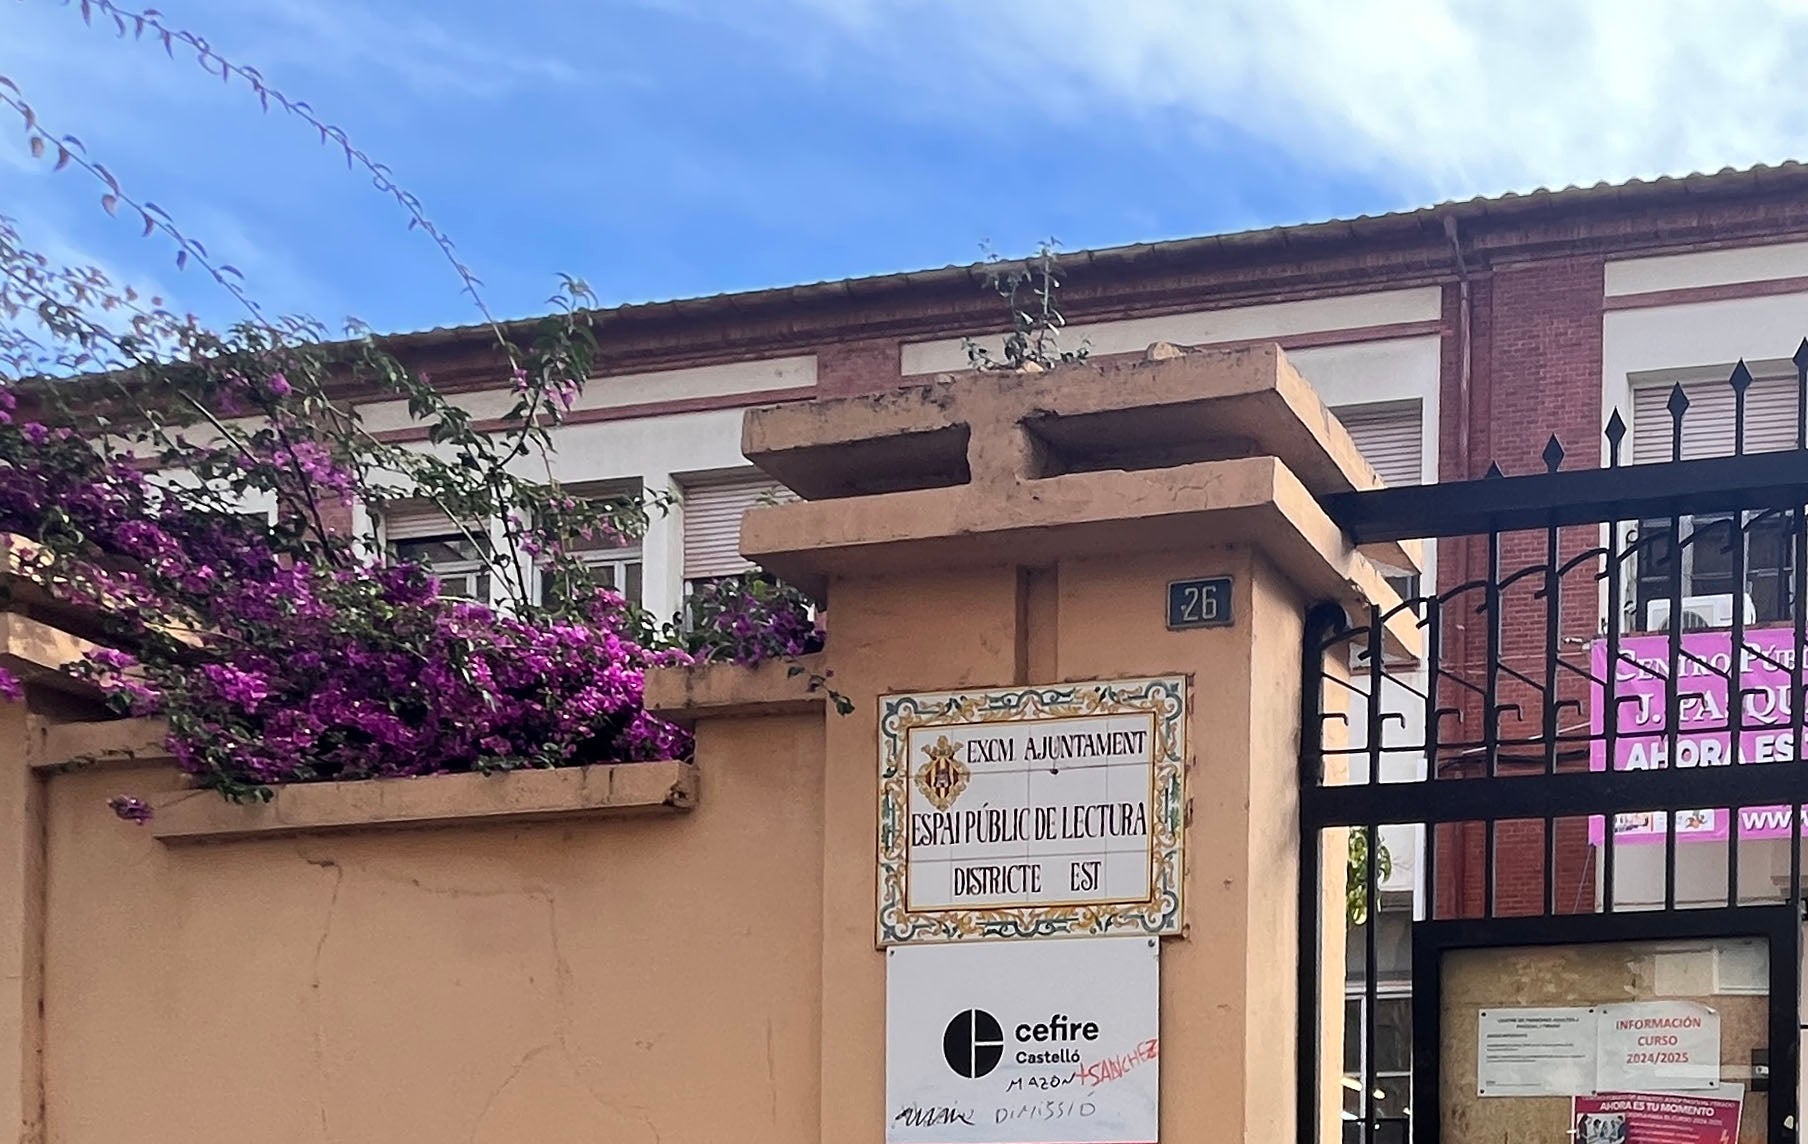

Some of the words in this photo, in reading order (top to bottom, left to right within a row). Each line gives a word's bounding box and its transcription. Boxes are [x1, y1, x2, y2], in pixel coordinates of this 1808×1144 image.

[1183, 586, 1217, 621] 26
[1636, 694, 1661, 725] J.
[967, 738, 1014, 763] EXCM
[1024, 730, 1147, 761] AJUNTAMENT
[912, 812, 960, 847] ESPAI
[965, 803, 1030, 843] PÚBLIC
[1035, 807, 1057, 841] DE
[1061, 802, 1148, 840] LECTURA
[954, 865, 1041, 896] DISTRICTE
[1070, 861, 1101, 892] EST
[1015, 1014, 1099, 1042] cefire
[1616, 1015, 1701, 1031] INFORMACIÓN
[1637, 1035, 1678, 1048] CURSO
[1016, 1049, 1080, 1064] Castelló
[1626, 1052, 1689, 1065] 2024/2025
[1600, 1101, 1632, 1111] AHORA
[1633, 1102, 1645, 1111] ES
[1646, 1103, 1658, 1112] TU
[1660, 1103, 1715, 1117] MOMENTO
